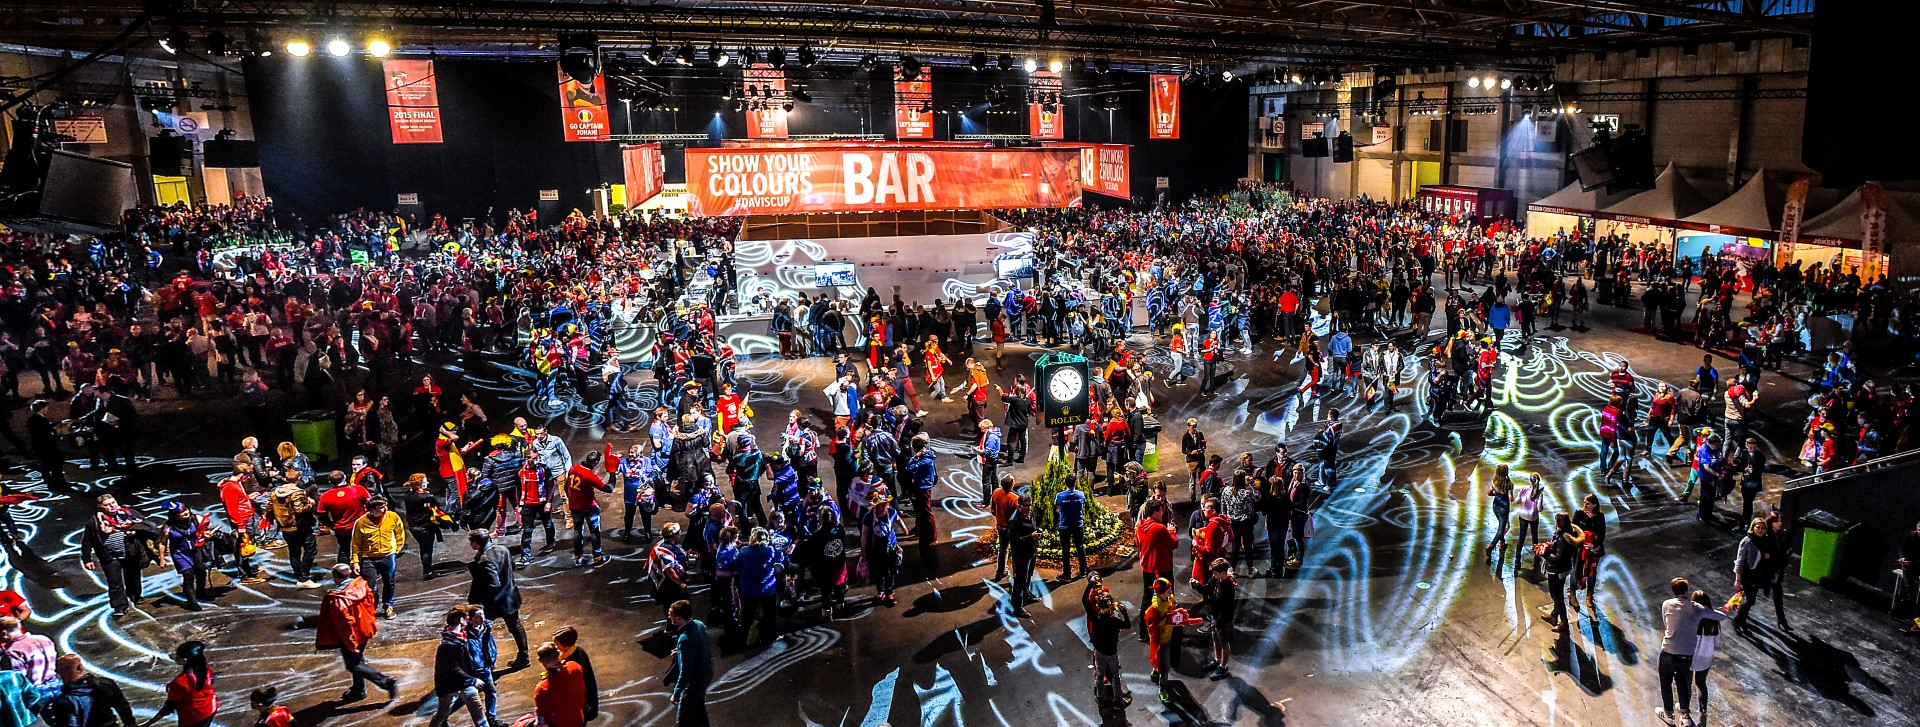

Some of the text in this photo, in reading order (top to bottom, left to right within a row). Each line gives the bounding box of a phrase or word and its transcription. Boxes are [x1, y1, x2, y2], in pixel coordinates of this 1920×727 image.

[708, 153, 811, 173] SHOW YOUR
[709, 172, 813, 197] COLOURS
[842, 152, 936, 205] BAR
[735, 196, 790, 208] #DAVISCUP
[1050, 415, 1081, 425] ROLEX
[569, 474, 581, 490] 12
